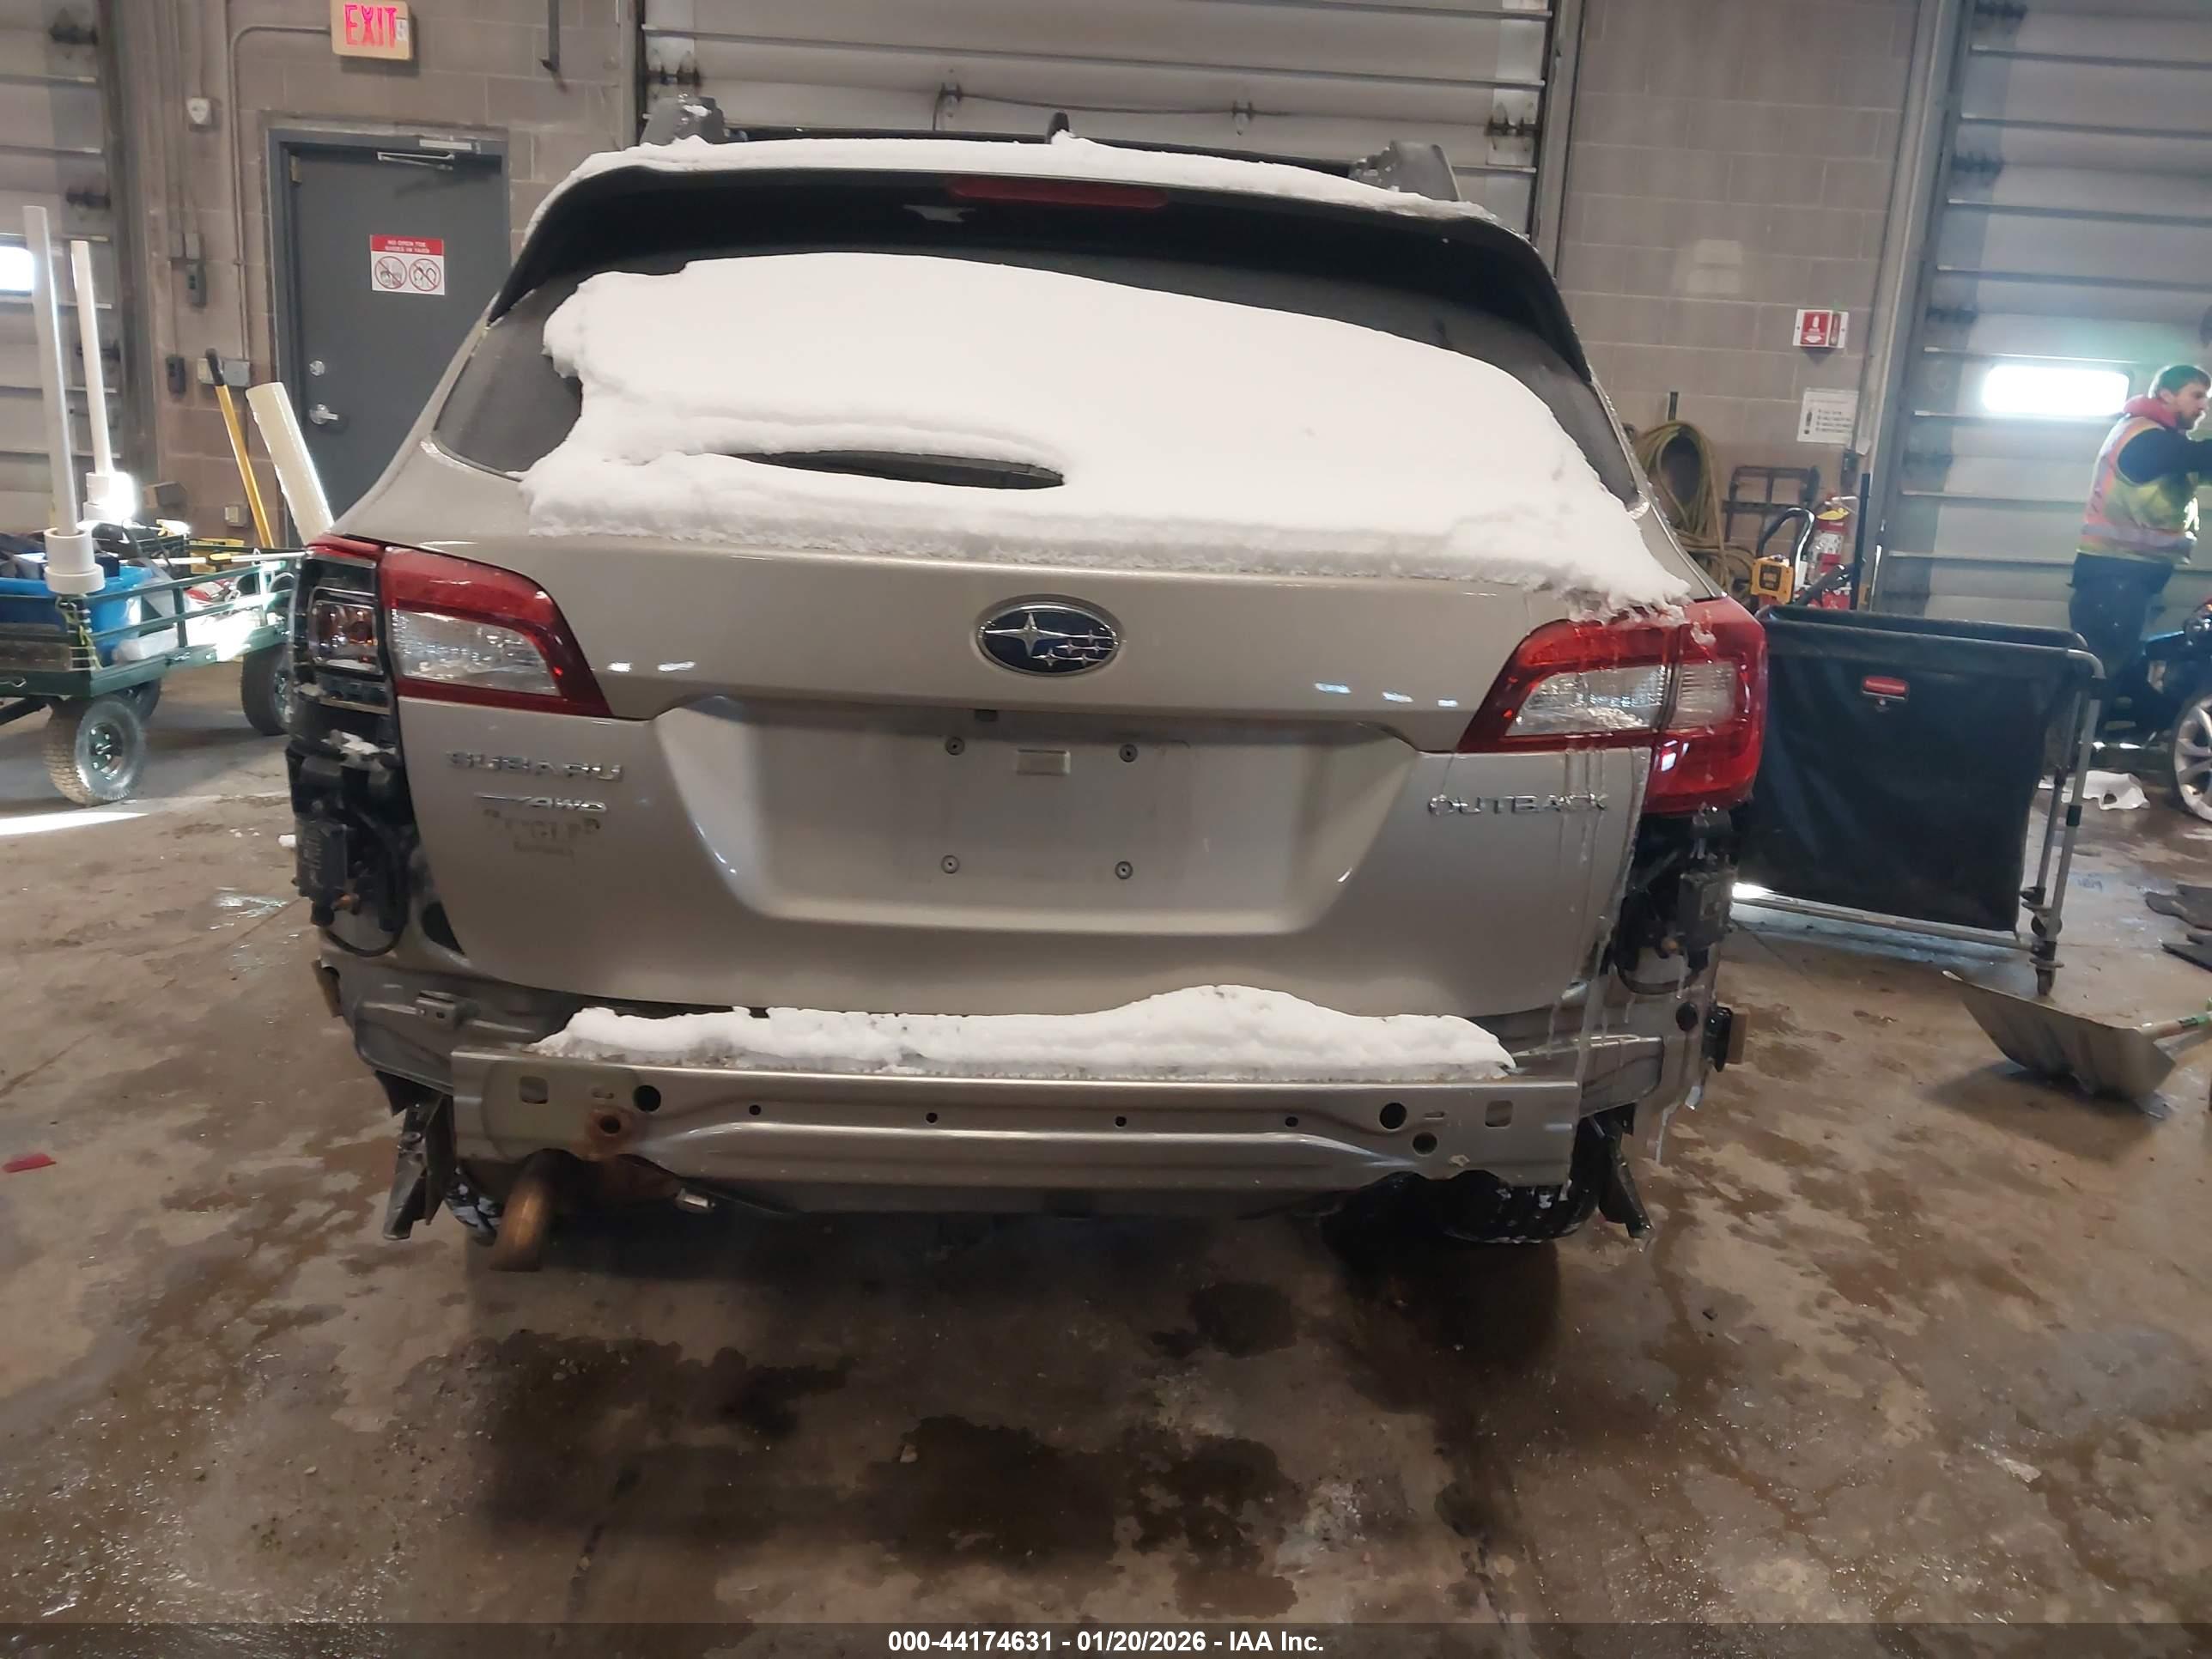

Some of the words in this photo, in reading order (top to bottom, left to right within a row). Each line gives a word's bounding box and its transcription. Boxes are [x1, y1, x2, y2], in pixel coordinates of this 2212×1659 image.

[344, 4, 398, 48] EXIT
[446, 750, 624, 781] SUBARU
[1428, 793, 1609, 816] OUTBACK
